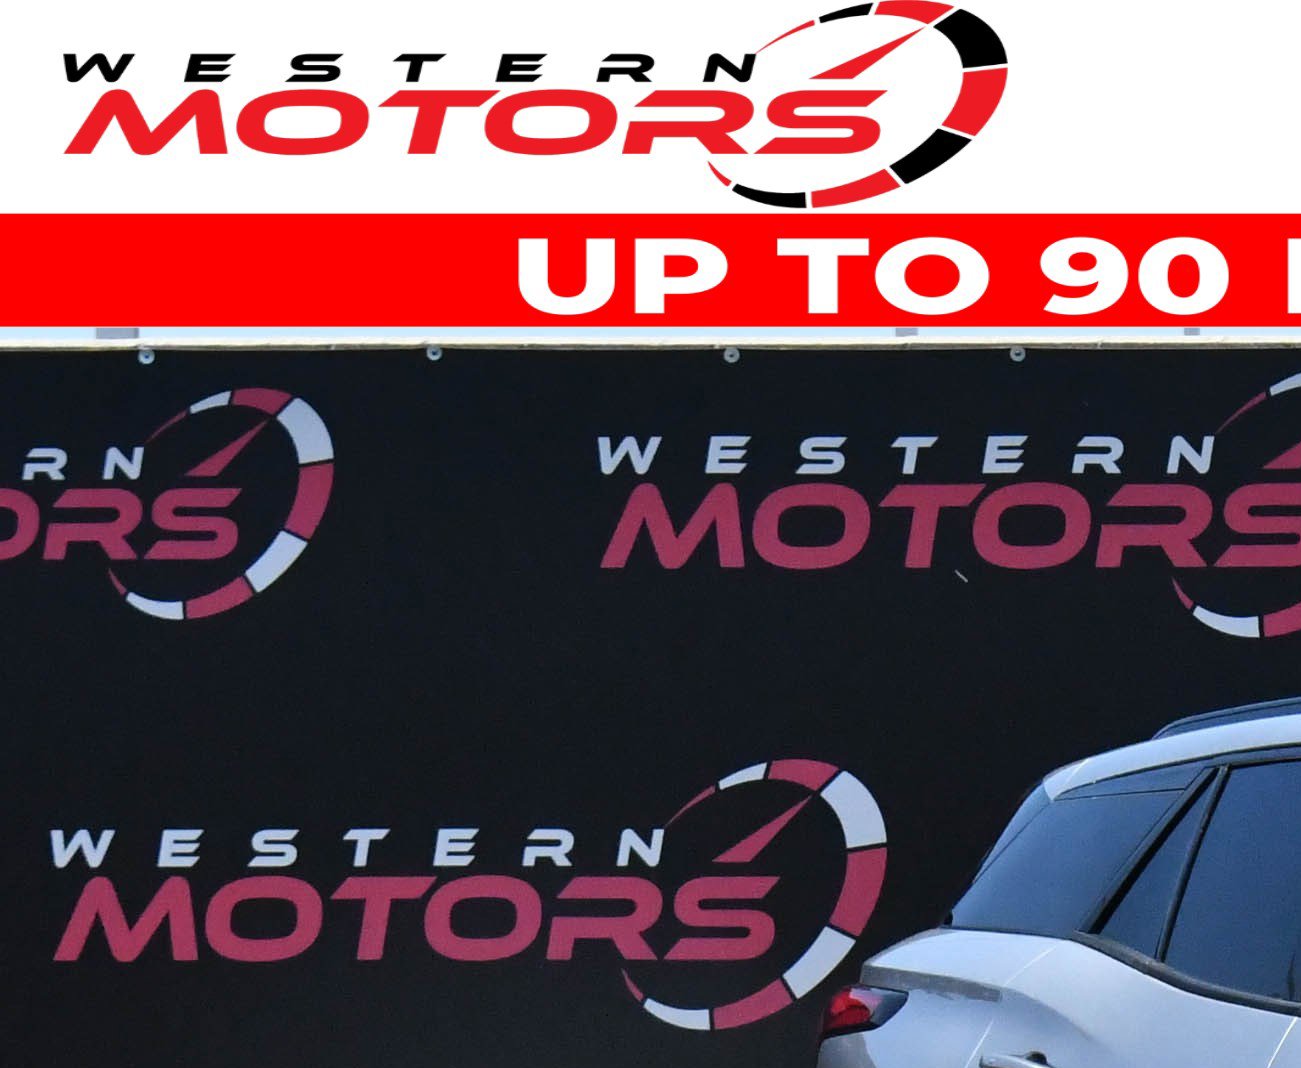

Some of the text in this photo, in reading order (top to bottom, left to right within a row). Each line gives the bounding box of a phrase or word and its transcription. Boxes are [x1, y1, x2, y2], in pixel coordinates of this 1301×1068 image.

[599, 436, 1215, 475] WESTERN
[50, 828, 665, 868] WESTERN
[53, 875, 781, 962] MOTORS
